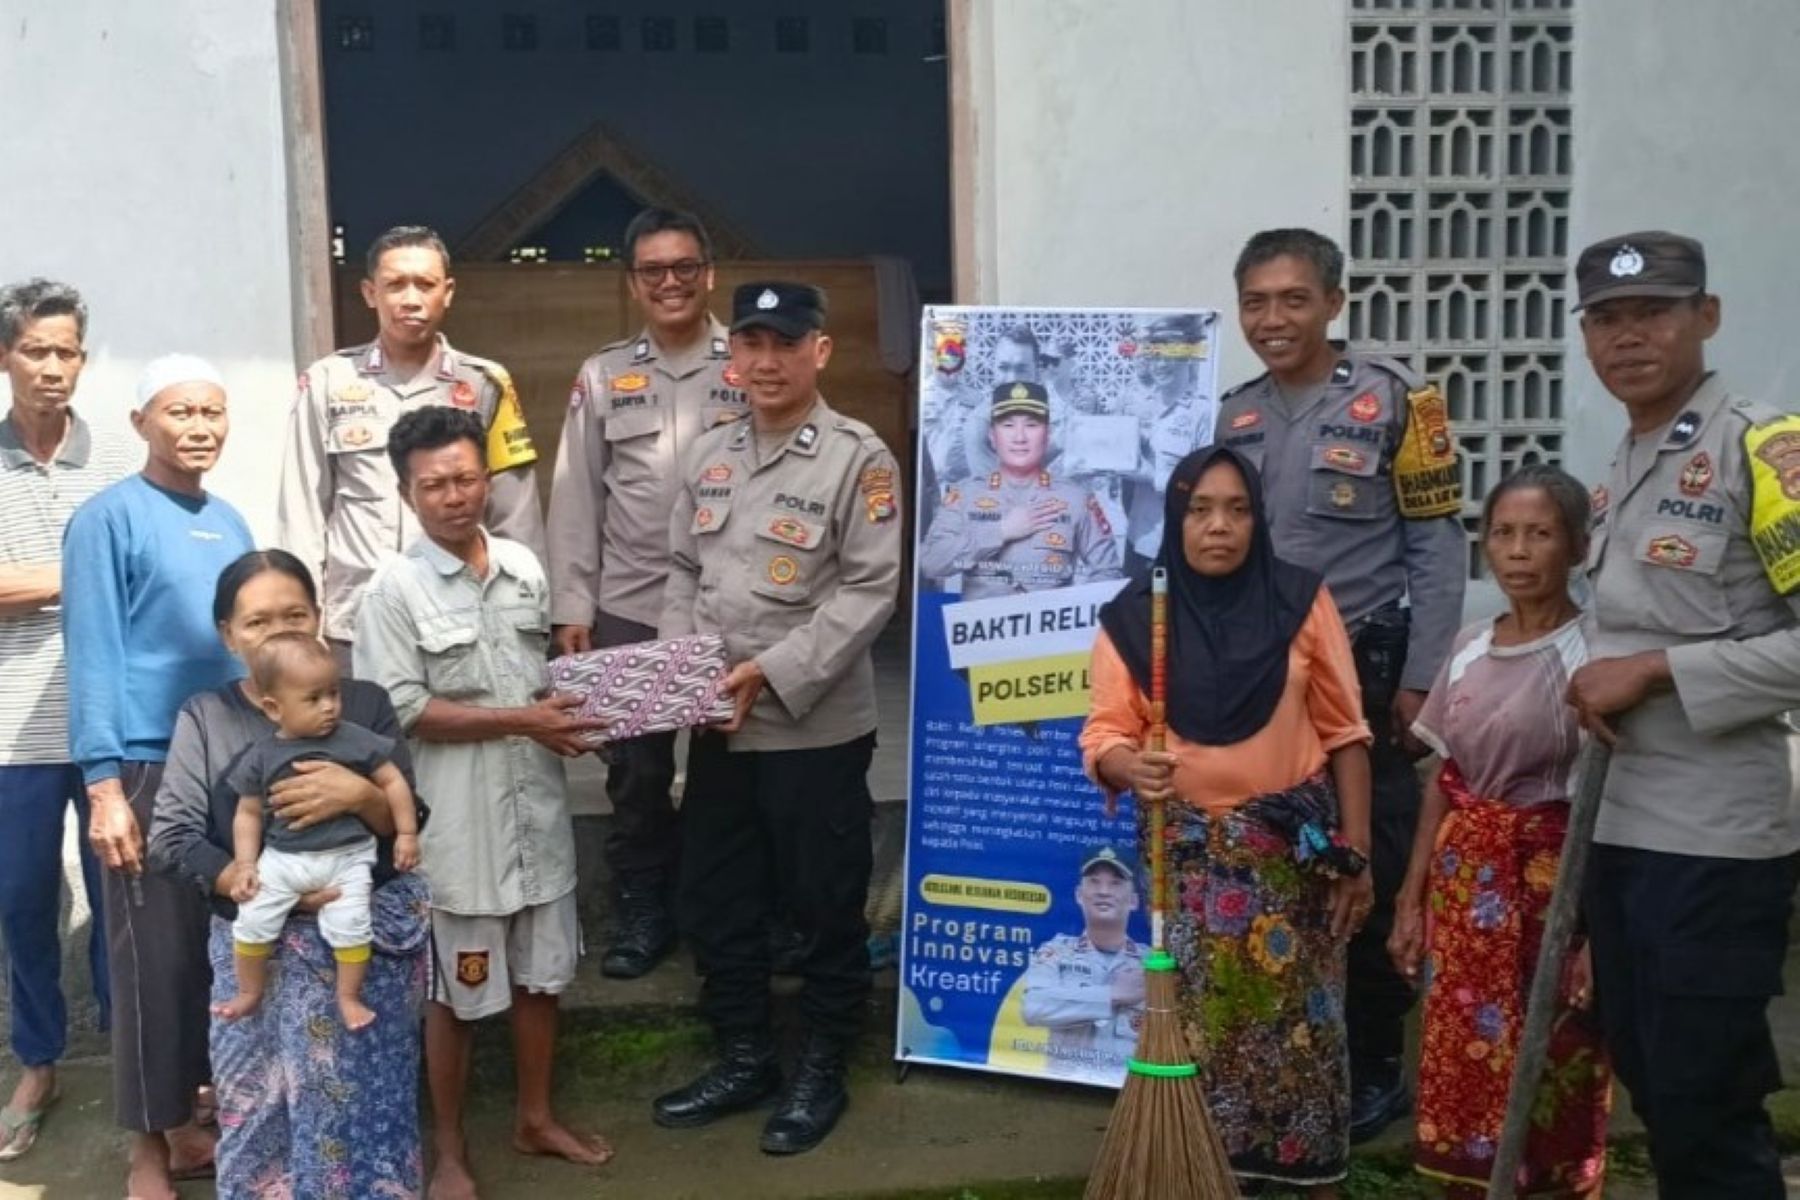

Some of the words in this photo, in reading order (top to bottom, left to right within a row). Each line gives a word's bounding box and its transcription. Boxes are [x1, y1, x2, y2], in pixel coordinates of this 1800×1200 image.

[1320, 423, 1380, 443] POLRI
[774, 492, 826, 516] POLRI
[1657, 499, 1724, 524] POLRI
[951, 611, 1032, 646] BAKTI
[1039, 603, 1100, 634] RELI
[977, 670, 1074, 703] POLSEK
[1080, 668, 1093, 690] L
[912, 912, 1032, 944] Program
[910, 962, 1003, 994] Kreatif
